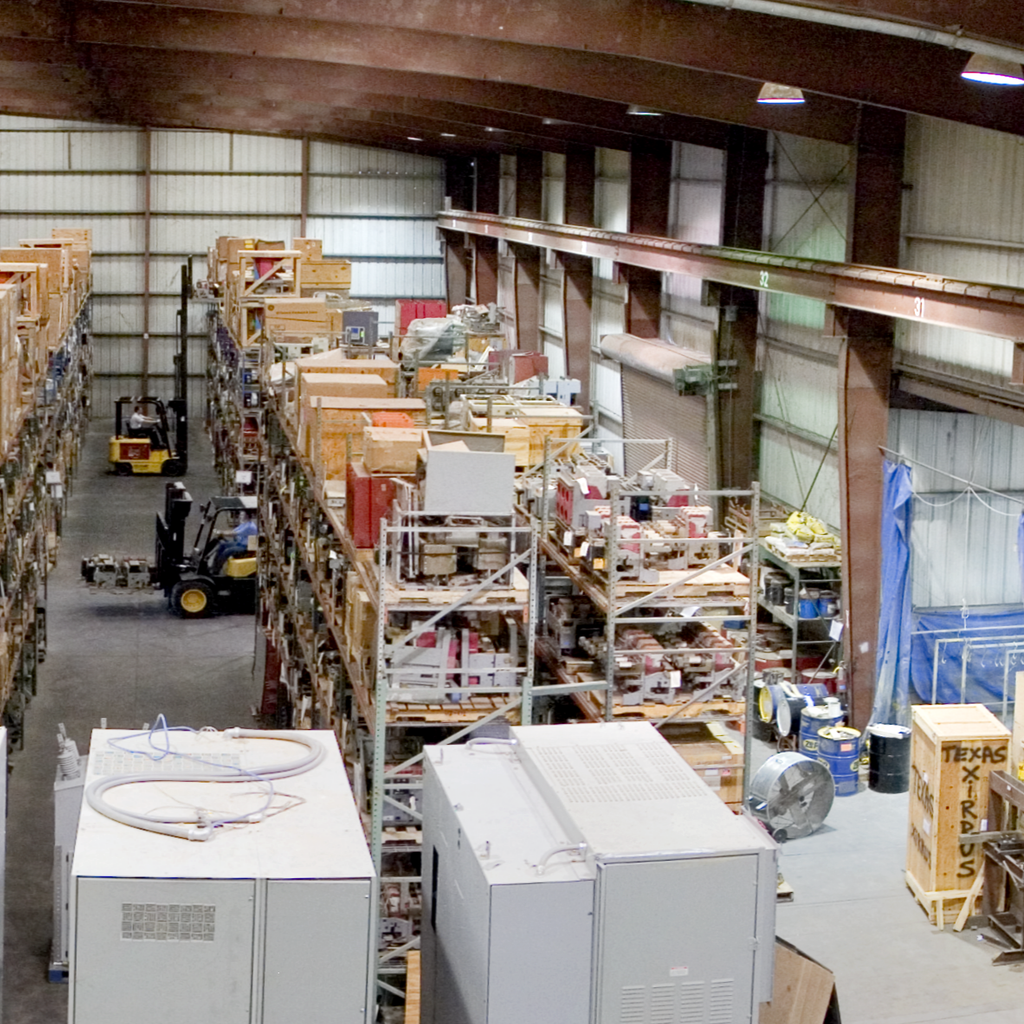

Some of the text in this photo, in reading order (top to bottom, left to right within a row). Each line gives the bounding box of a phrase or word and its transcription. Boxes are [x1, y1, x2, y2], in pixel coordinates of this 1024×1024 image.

[759, 270, 769, 288] 32
[914, 296, 925, 318] 31
[941, 745, 1008, 764] TEXAS
